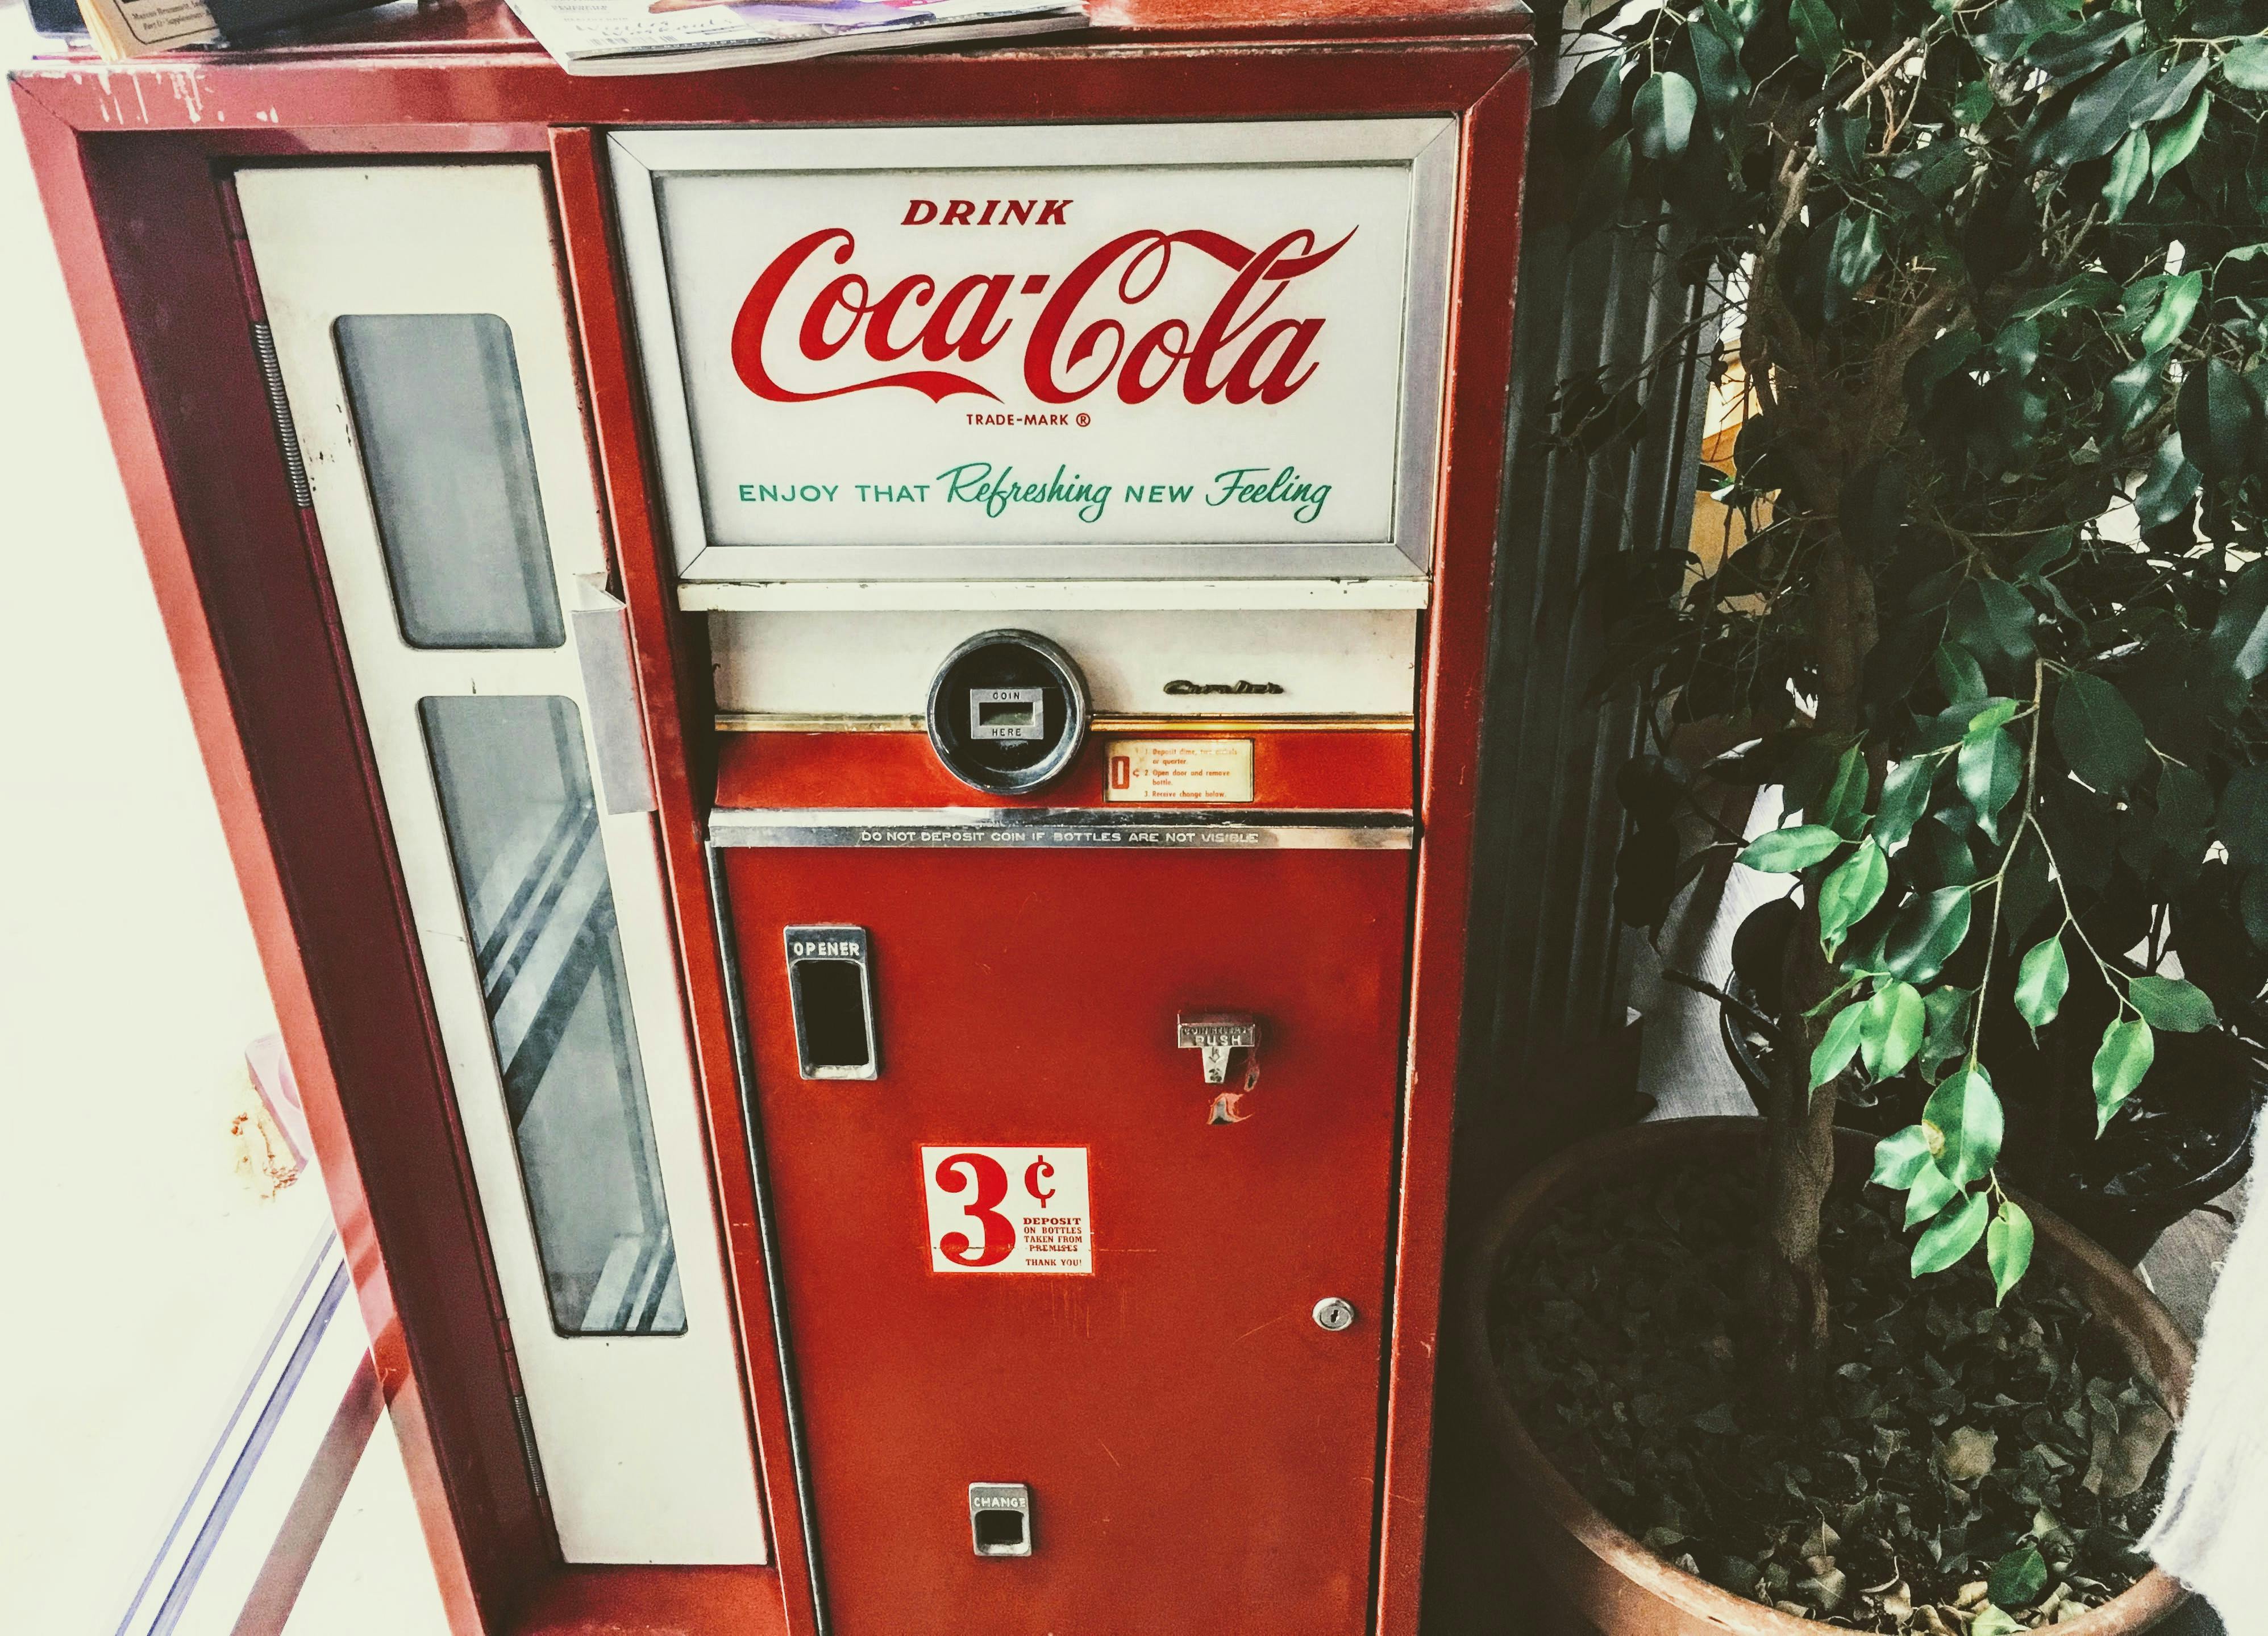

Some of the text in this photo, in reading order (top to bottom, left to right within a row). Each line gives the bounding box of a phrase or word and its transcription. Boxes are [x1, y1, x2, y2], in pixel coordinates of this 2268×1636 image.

[901, 200, 1073, 225] DRINK
[731, 225, 1358, 404] Coca-Cola
[967, 413, 1068, 426] TRADE-MARK
[739, 462, 1332, 524] ENJOY THAT Refreshing NEW Feeling
[993, 691, 1020, 700] COIN
[992, 728, 1021, 737] HERE
[1180, 790, 1202, 799] change
[861, 830, 1259, 843] DO NOT DEPOSIT COIN IF BOTTLES ARE NOT VISIBLE
[793, 942, 860, 956] OPENER
[1195, 1035, 1241, 1046] PUSH
[974, 1497, 1026, 1508] CHANGE
